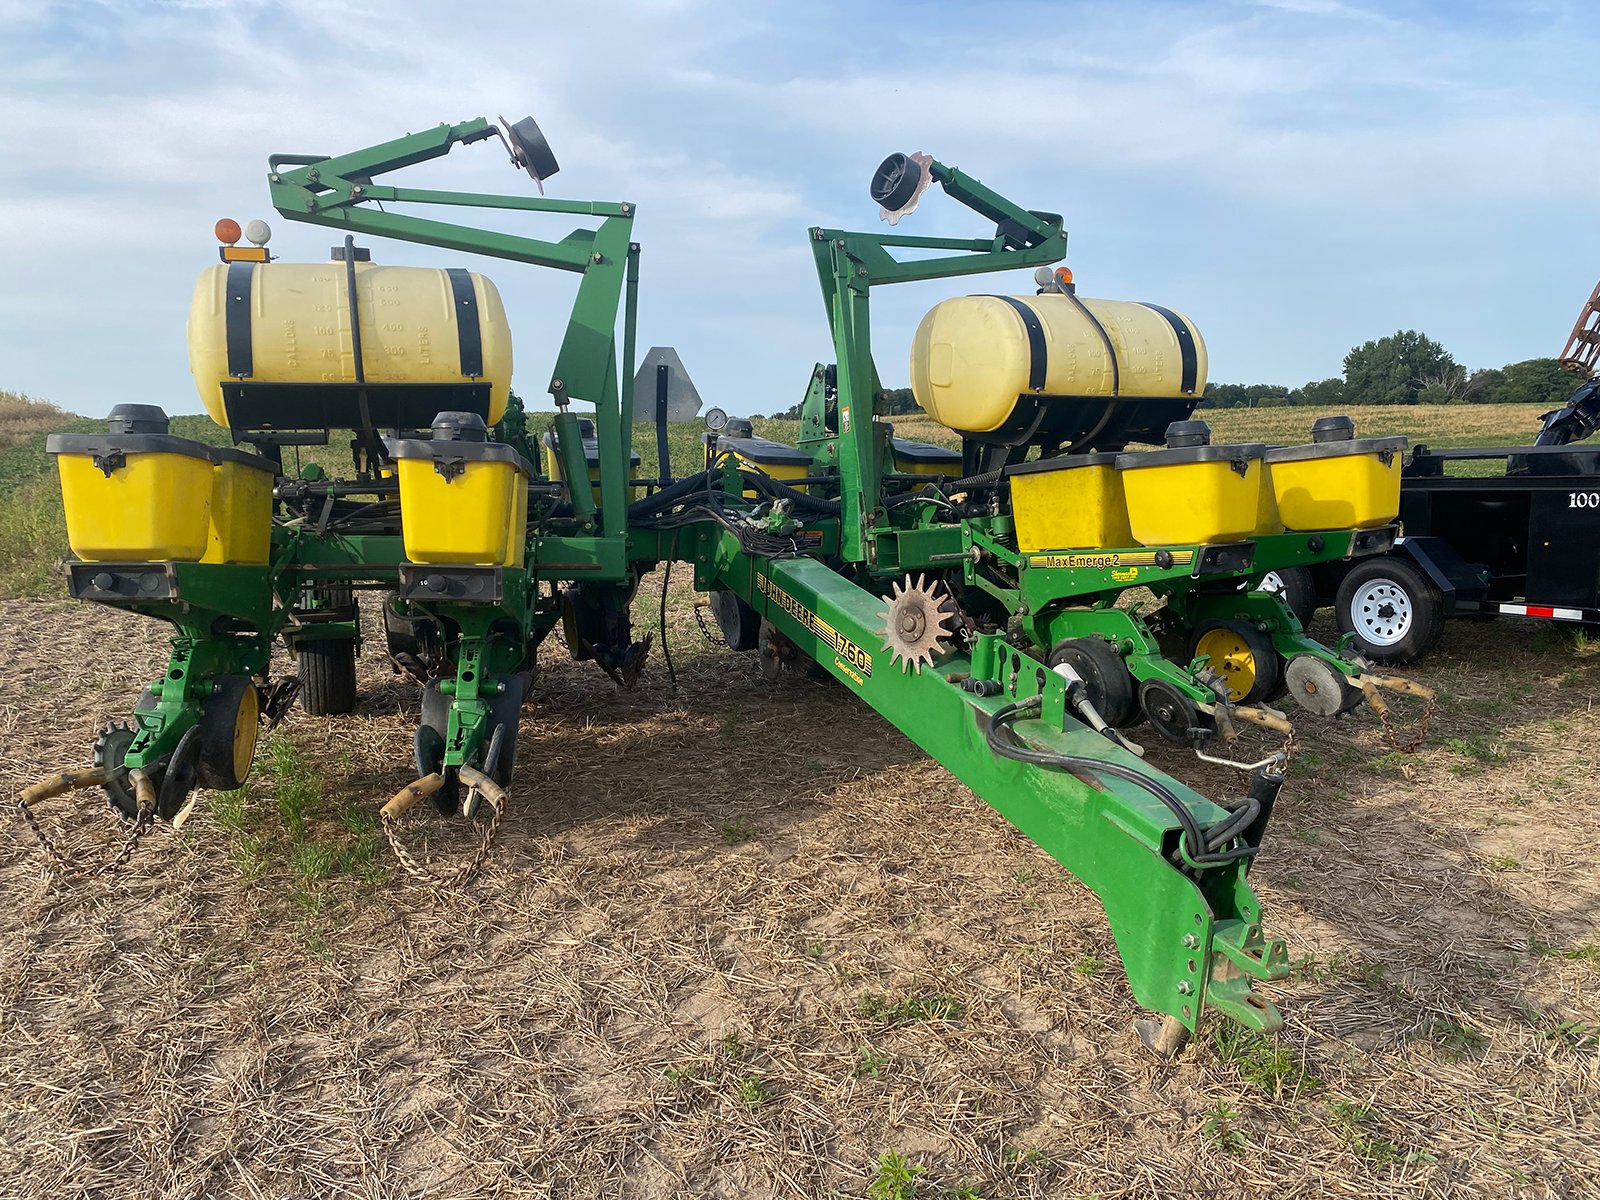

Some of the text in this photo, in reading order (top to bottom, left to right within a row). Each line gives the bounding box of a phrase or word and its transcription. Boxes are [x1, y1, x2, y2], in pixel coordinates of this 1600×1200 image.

[314, 325, 335, 336] 100
[382, 322, 404, 332] 400
[285, 320, 298, 368] GALLONS
[320, 348, 335, 359] 75
[419, 326, 431, 365] LITERS
[1068, 344, 1077, 383] GALLONS
[1155, 351, 1164, 382] LITERS
[1568, 493, 1600, 508] 100
[760, 576, 866, 672] JOHN DEERE 1760
[834, 656, 865, 687] Conservation
